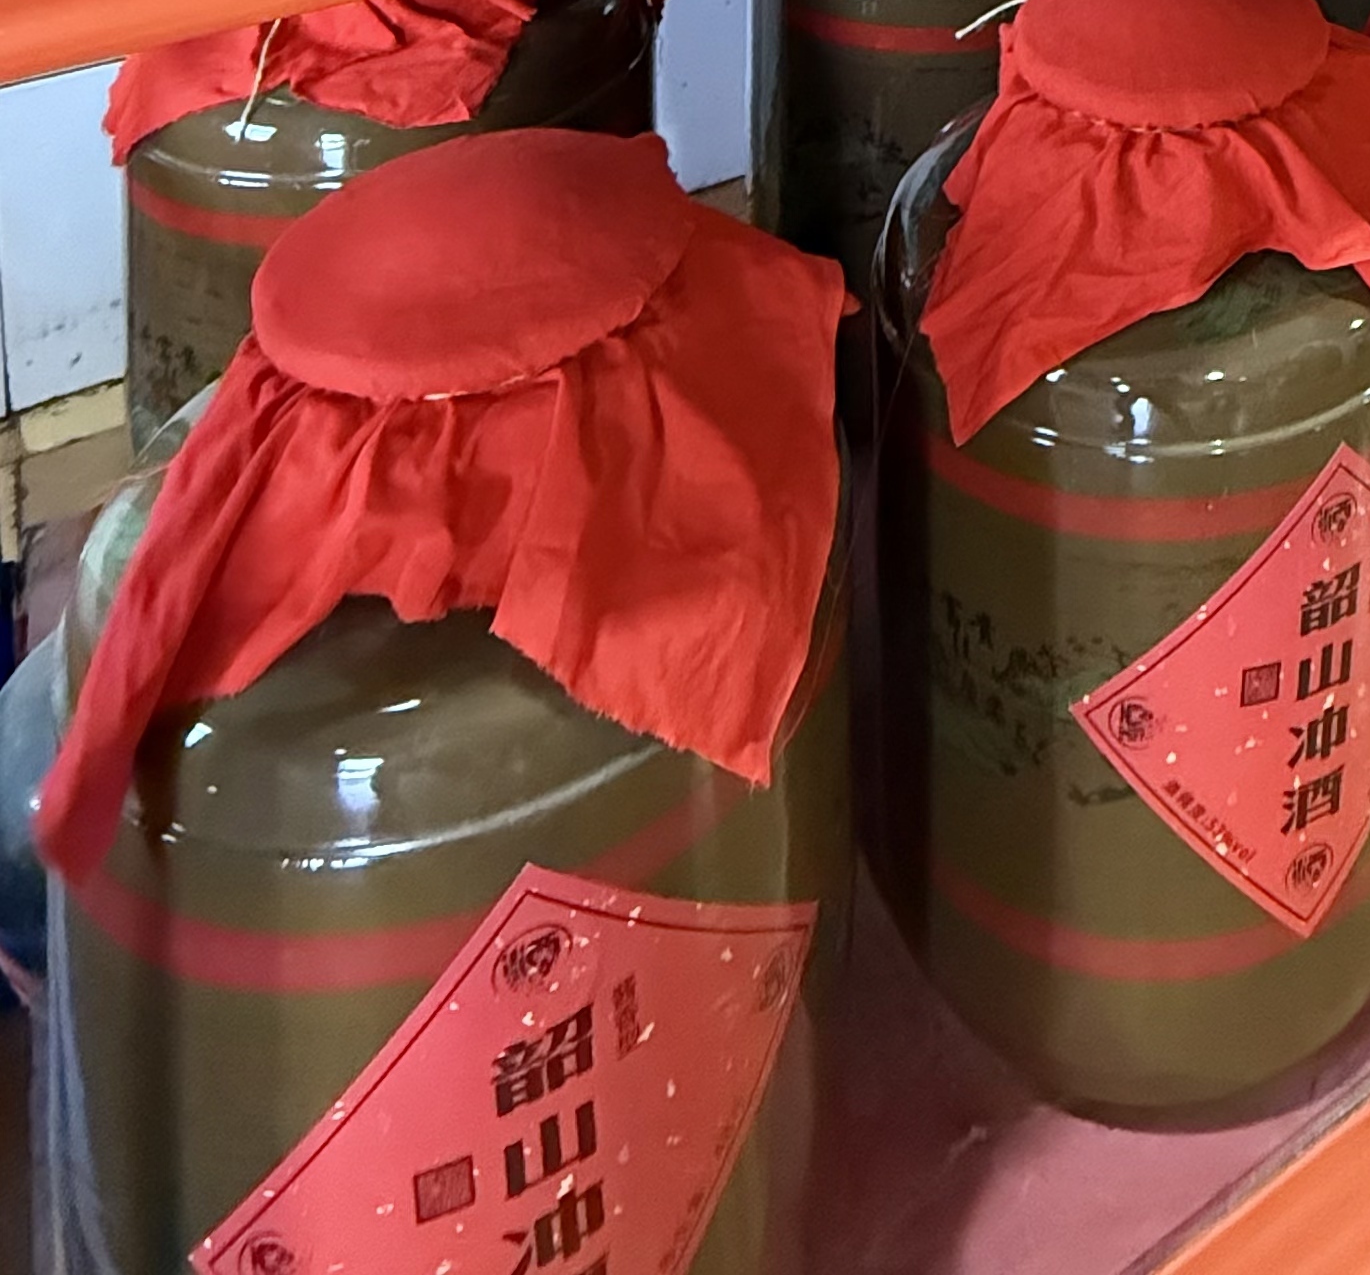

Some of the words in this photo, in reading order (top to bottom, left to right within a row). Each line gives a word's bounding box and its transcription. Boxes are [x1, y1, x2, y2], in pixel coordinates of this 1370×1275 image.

[1280, 561, 1361, 836] 韶山冲酒
[491, 1002, 606, 1275] 韶山冲
